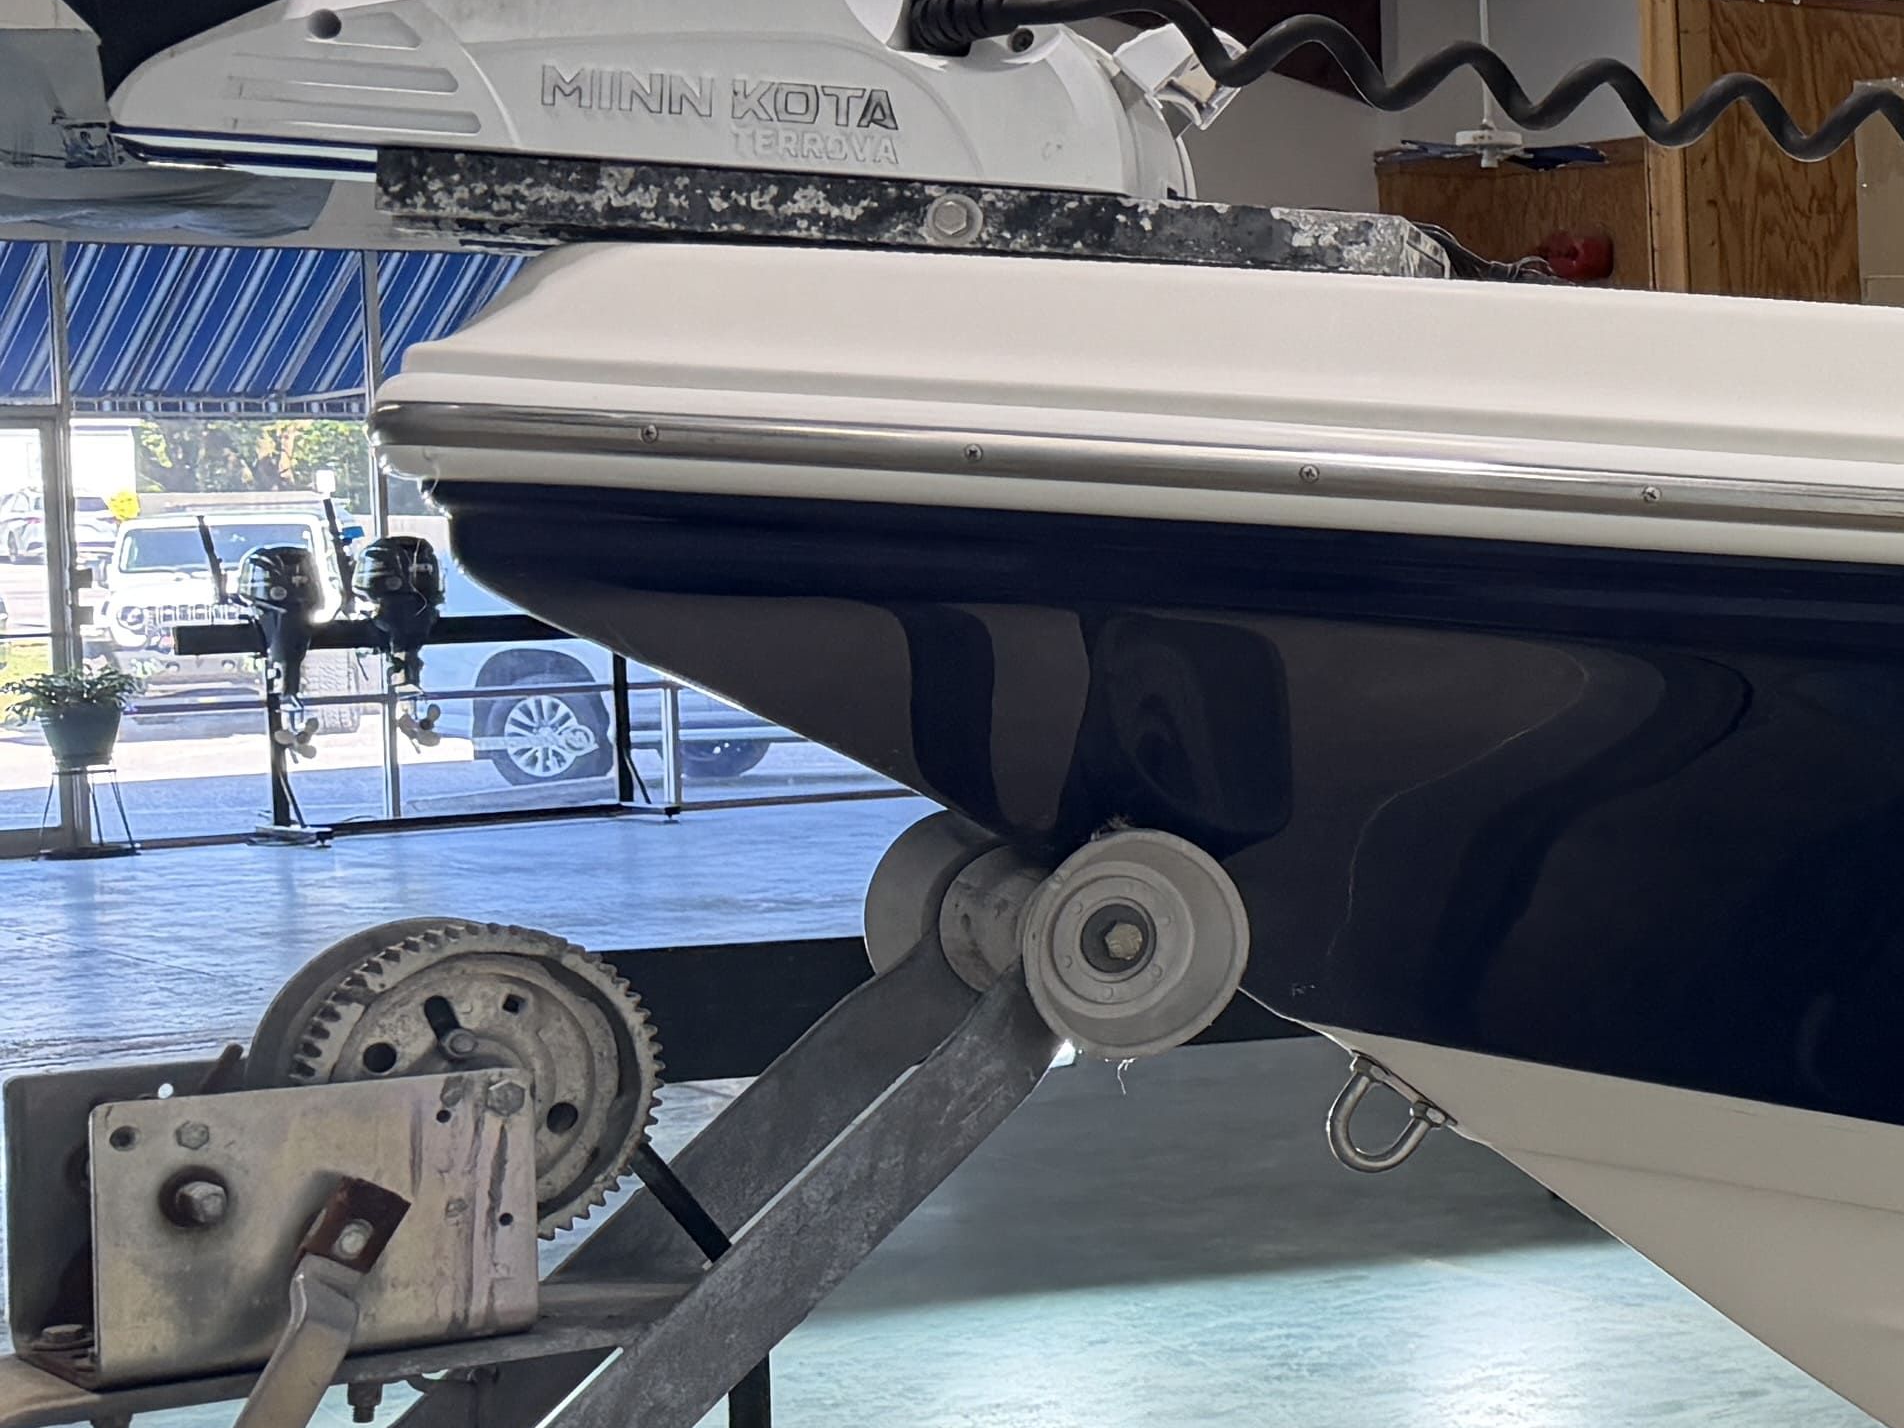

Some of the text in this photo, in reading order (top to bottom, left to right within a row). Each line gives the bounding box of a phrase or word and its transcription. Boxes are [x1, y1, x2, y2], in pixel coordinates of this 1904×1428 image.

[541, 64, 899, 130] MINN KOTA
[728, 126, 900, 165] TERROVA
